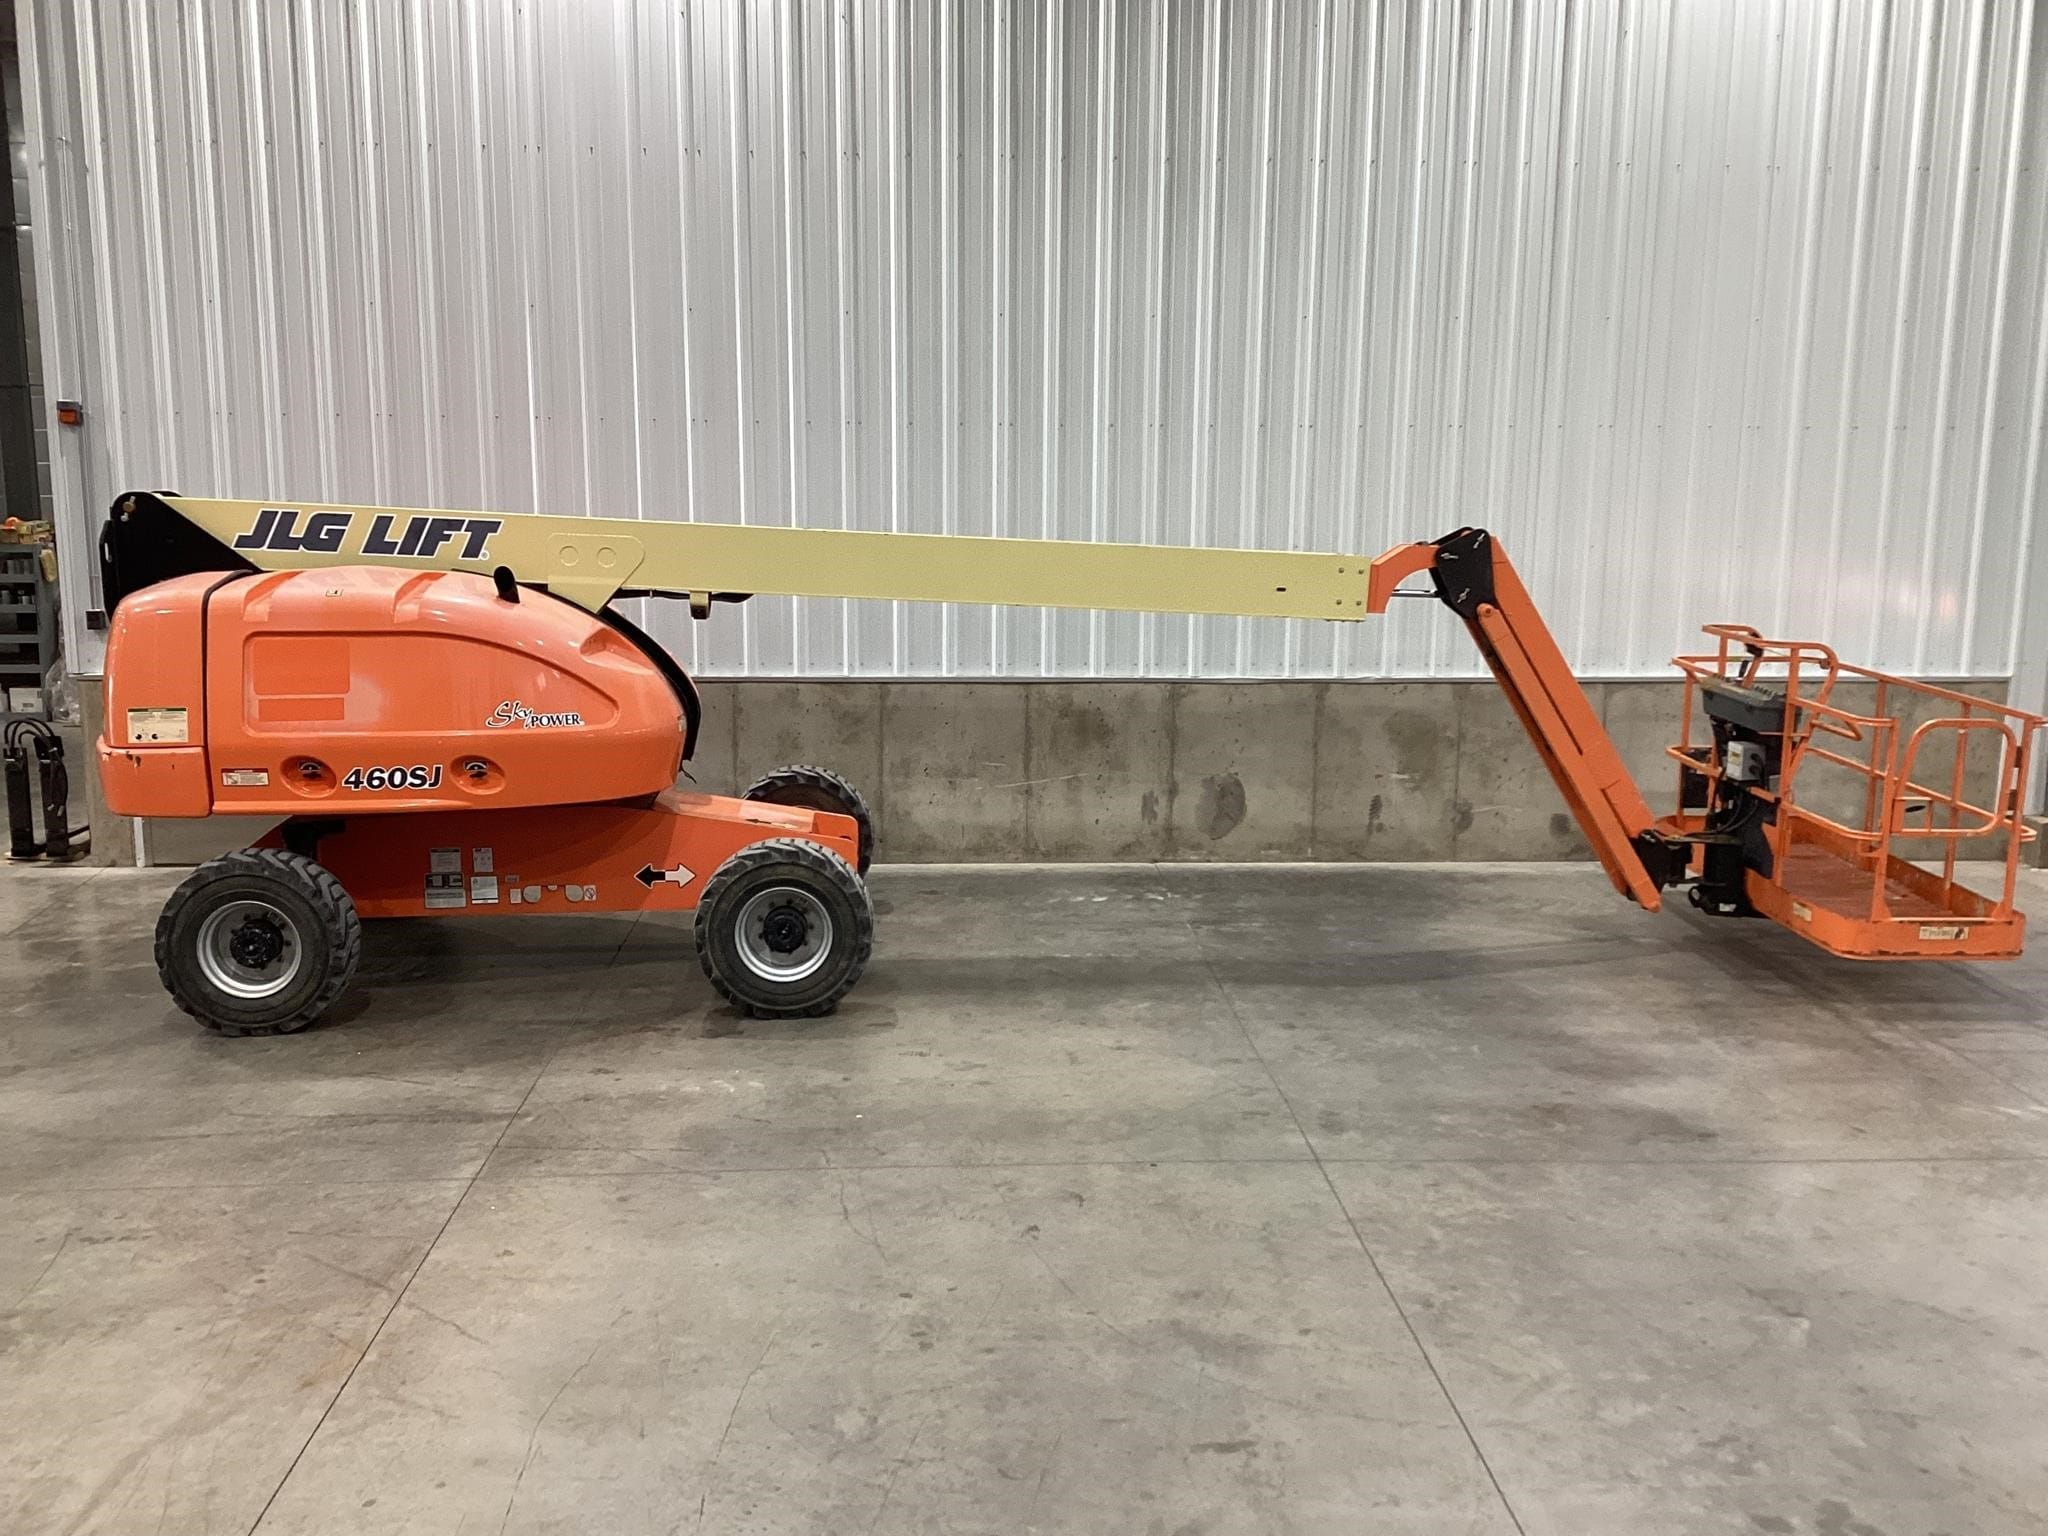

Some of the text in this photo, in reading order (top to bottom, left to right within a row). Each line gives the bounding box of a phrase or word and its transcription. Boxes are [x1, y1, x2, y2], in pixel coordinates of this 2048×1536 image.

[233, 510, 502, 559] JLG LIFT
[486, 700, 581, 728] Sky POWER
[343, 765, 442, 790] 460SJ
